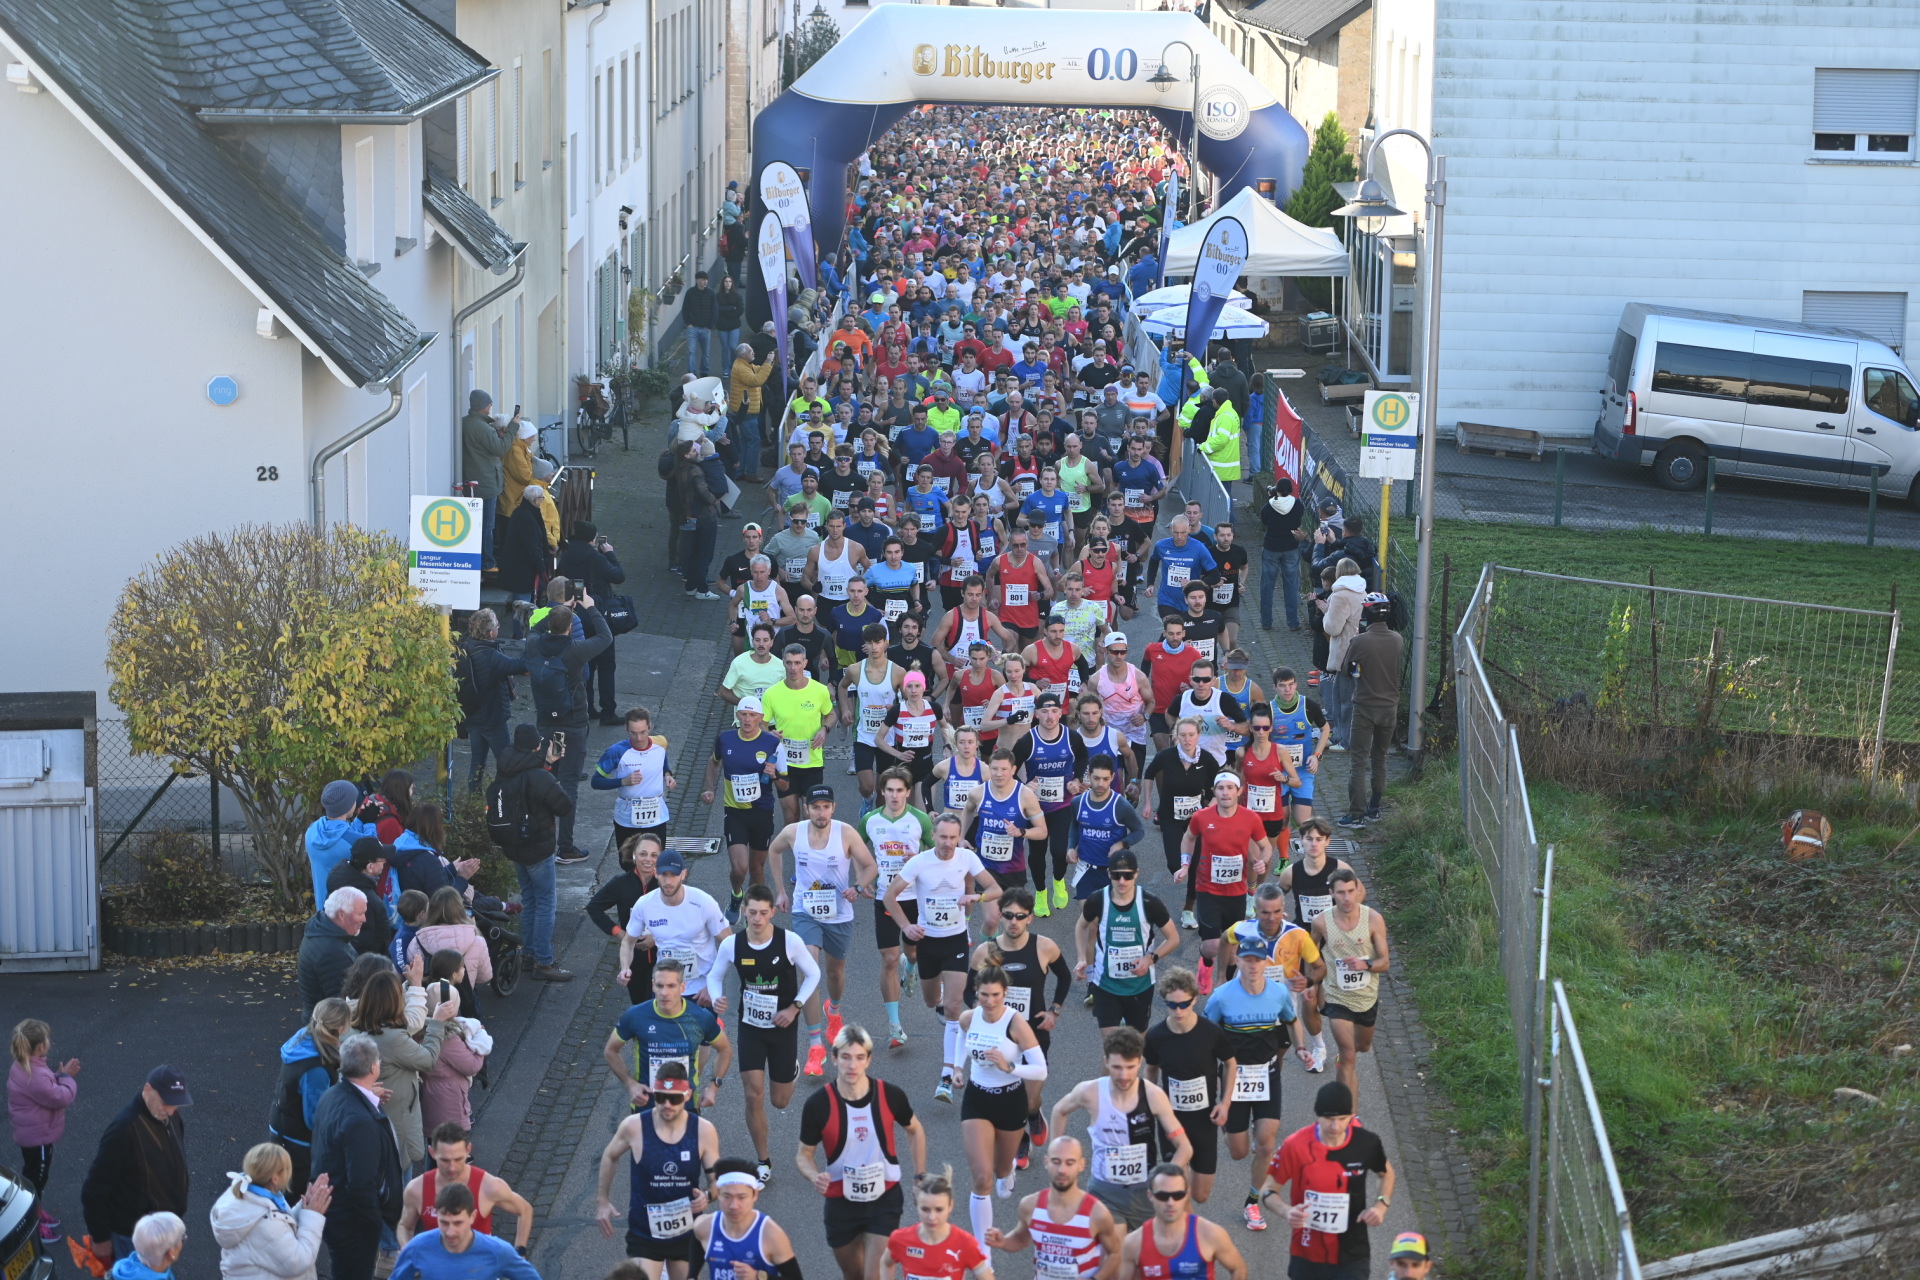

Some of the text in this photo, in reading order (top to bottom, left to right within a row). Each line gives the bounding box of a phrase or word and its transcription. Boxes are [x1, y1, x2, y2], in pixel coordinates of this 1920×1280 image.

[941, 44, 1056, 84] Bitburger
[1087, 47, 1138, 81] 0.0
[1207, 102, 1237, 117] ISO
[765, 186, 800, 200] Bitburger
[1205, 243, 1243, 265] Bitburger
[1216, 263, 1228, 275] 0.0
[1383, 401, 1399, 423] H
[256, 466, 279, 481] 28
[436, 509, 457, 536] H
[829, 584, 843, 592] 479
[1038, 761, 1067, 770] ASPORT
[736, 786, 757, 796] 1137
[1041, 789, 1058, 797] 864
[1255, 798, 1266, 806] 11
[635, 810, 657, 820] 1171
[1082, 828, 1111, 838] ASPORT
[985, 845, 1009, 855] 1337
[1215, 869, 1239, 877] 1236
[811, 905, 830, 915] 159
[935, 912, 949, 921] 24
[1343, 973, 1364, 983] 967
[747, 1007, 772, 1020] 1083
[971, 1049, 987, 1060] 93
[1236, 1082, 1265, 1093] 1279
[1174, 1093, 1203, 1104] 1280
[1111, 1163, 1142, 1176] 1202
[852, 1182, 876, 1194] 567
[1312, 1210, 1338, 1224] 217
[655, 1216, 687, 1232] 1051
